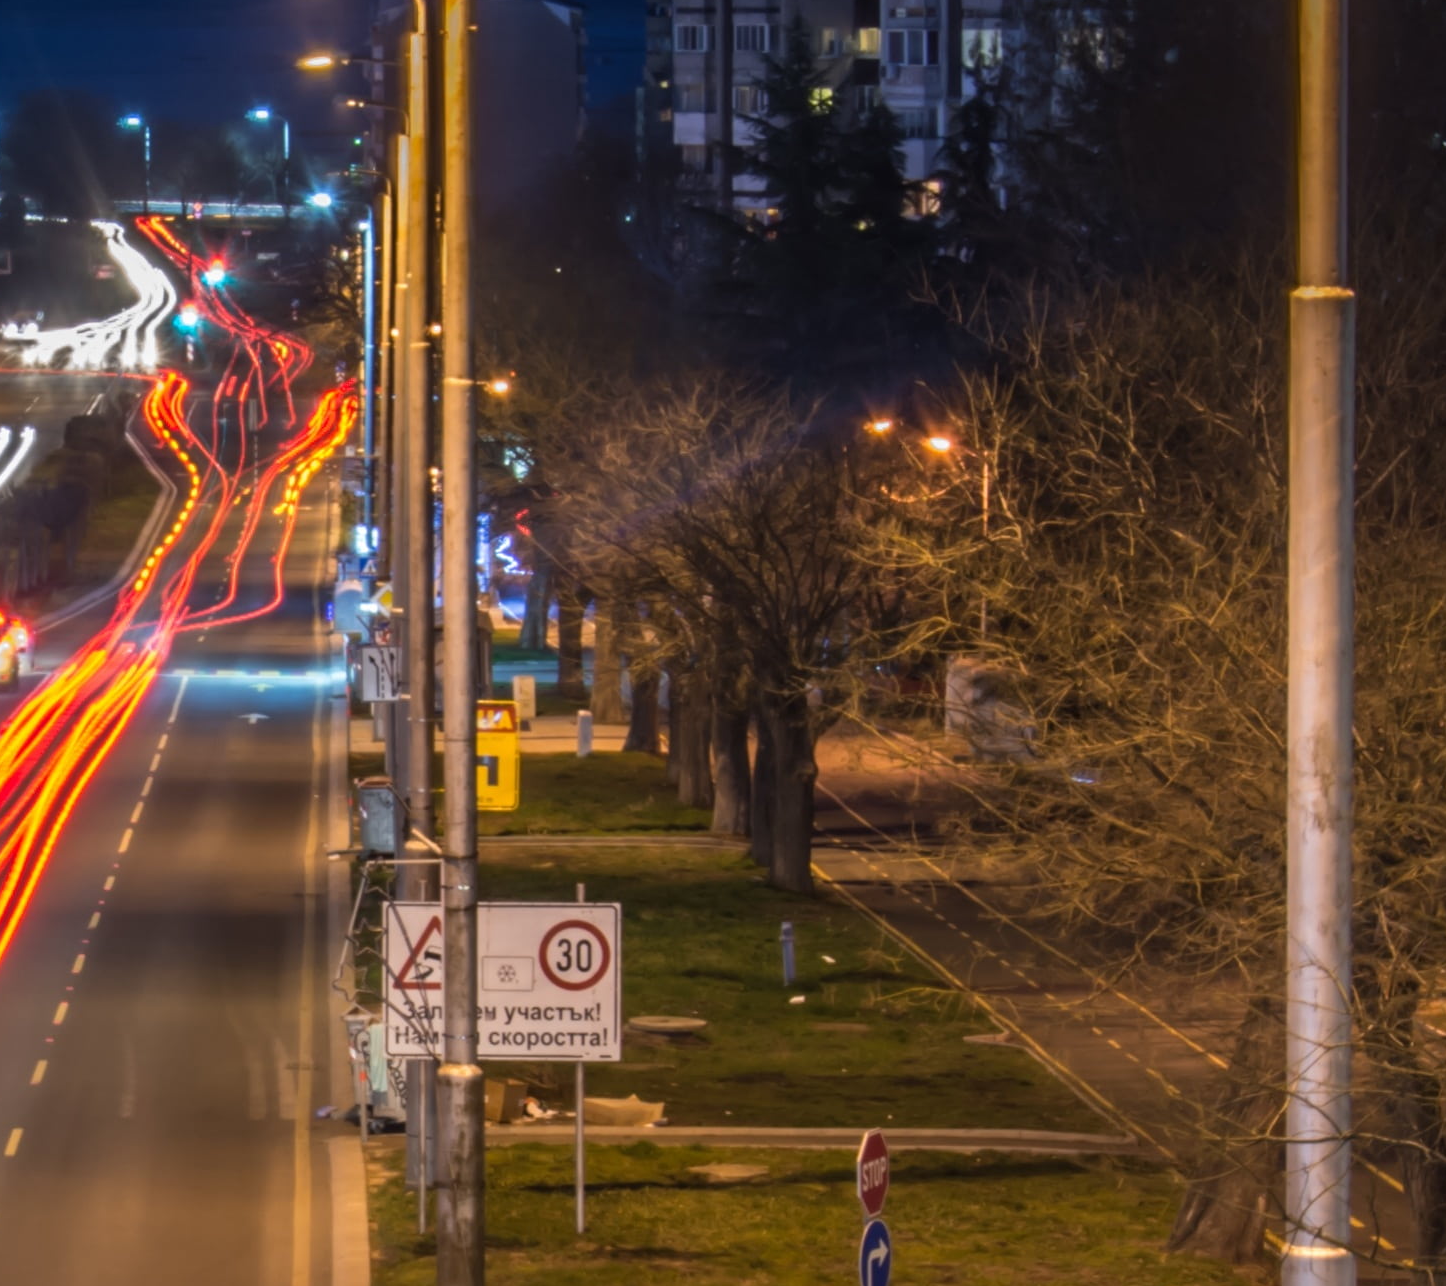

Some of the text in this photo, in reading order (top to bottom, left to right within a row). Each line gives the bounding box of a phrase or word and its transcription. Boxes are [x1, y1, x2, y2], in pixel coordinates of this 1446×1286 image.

[556, 938, 592, 973] 30
[504, 1002, 601, 1025] участък!
[488, 1027, 608, 1050] скоростта!
[862, 1156, 887, 1192] STOP
